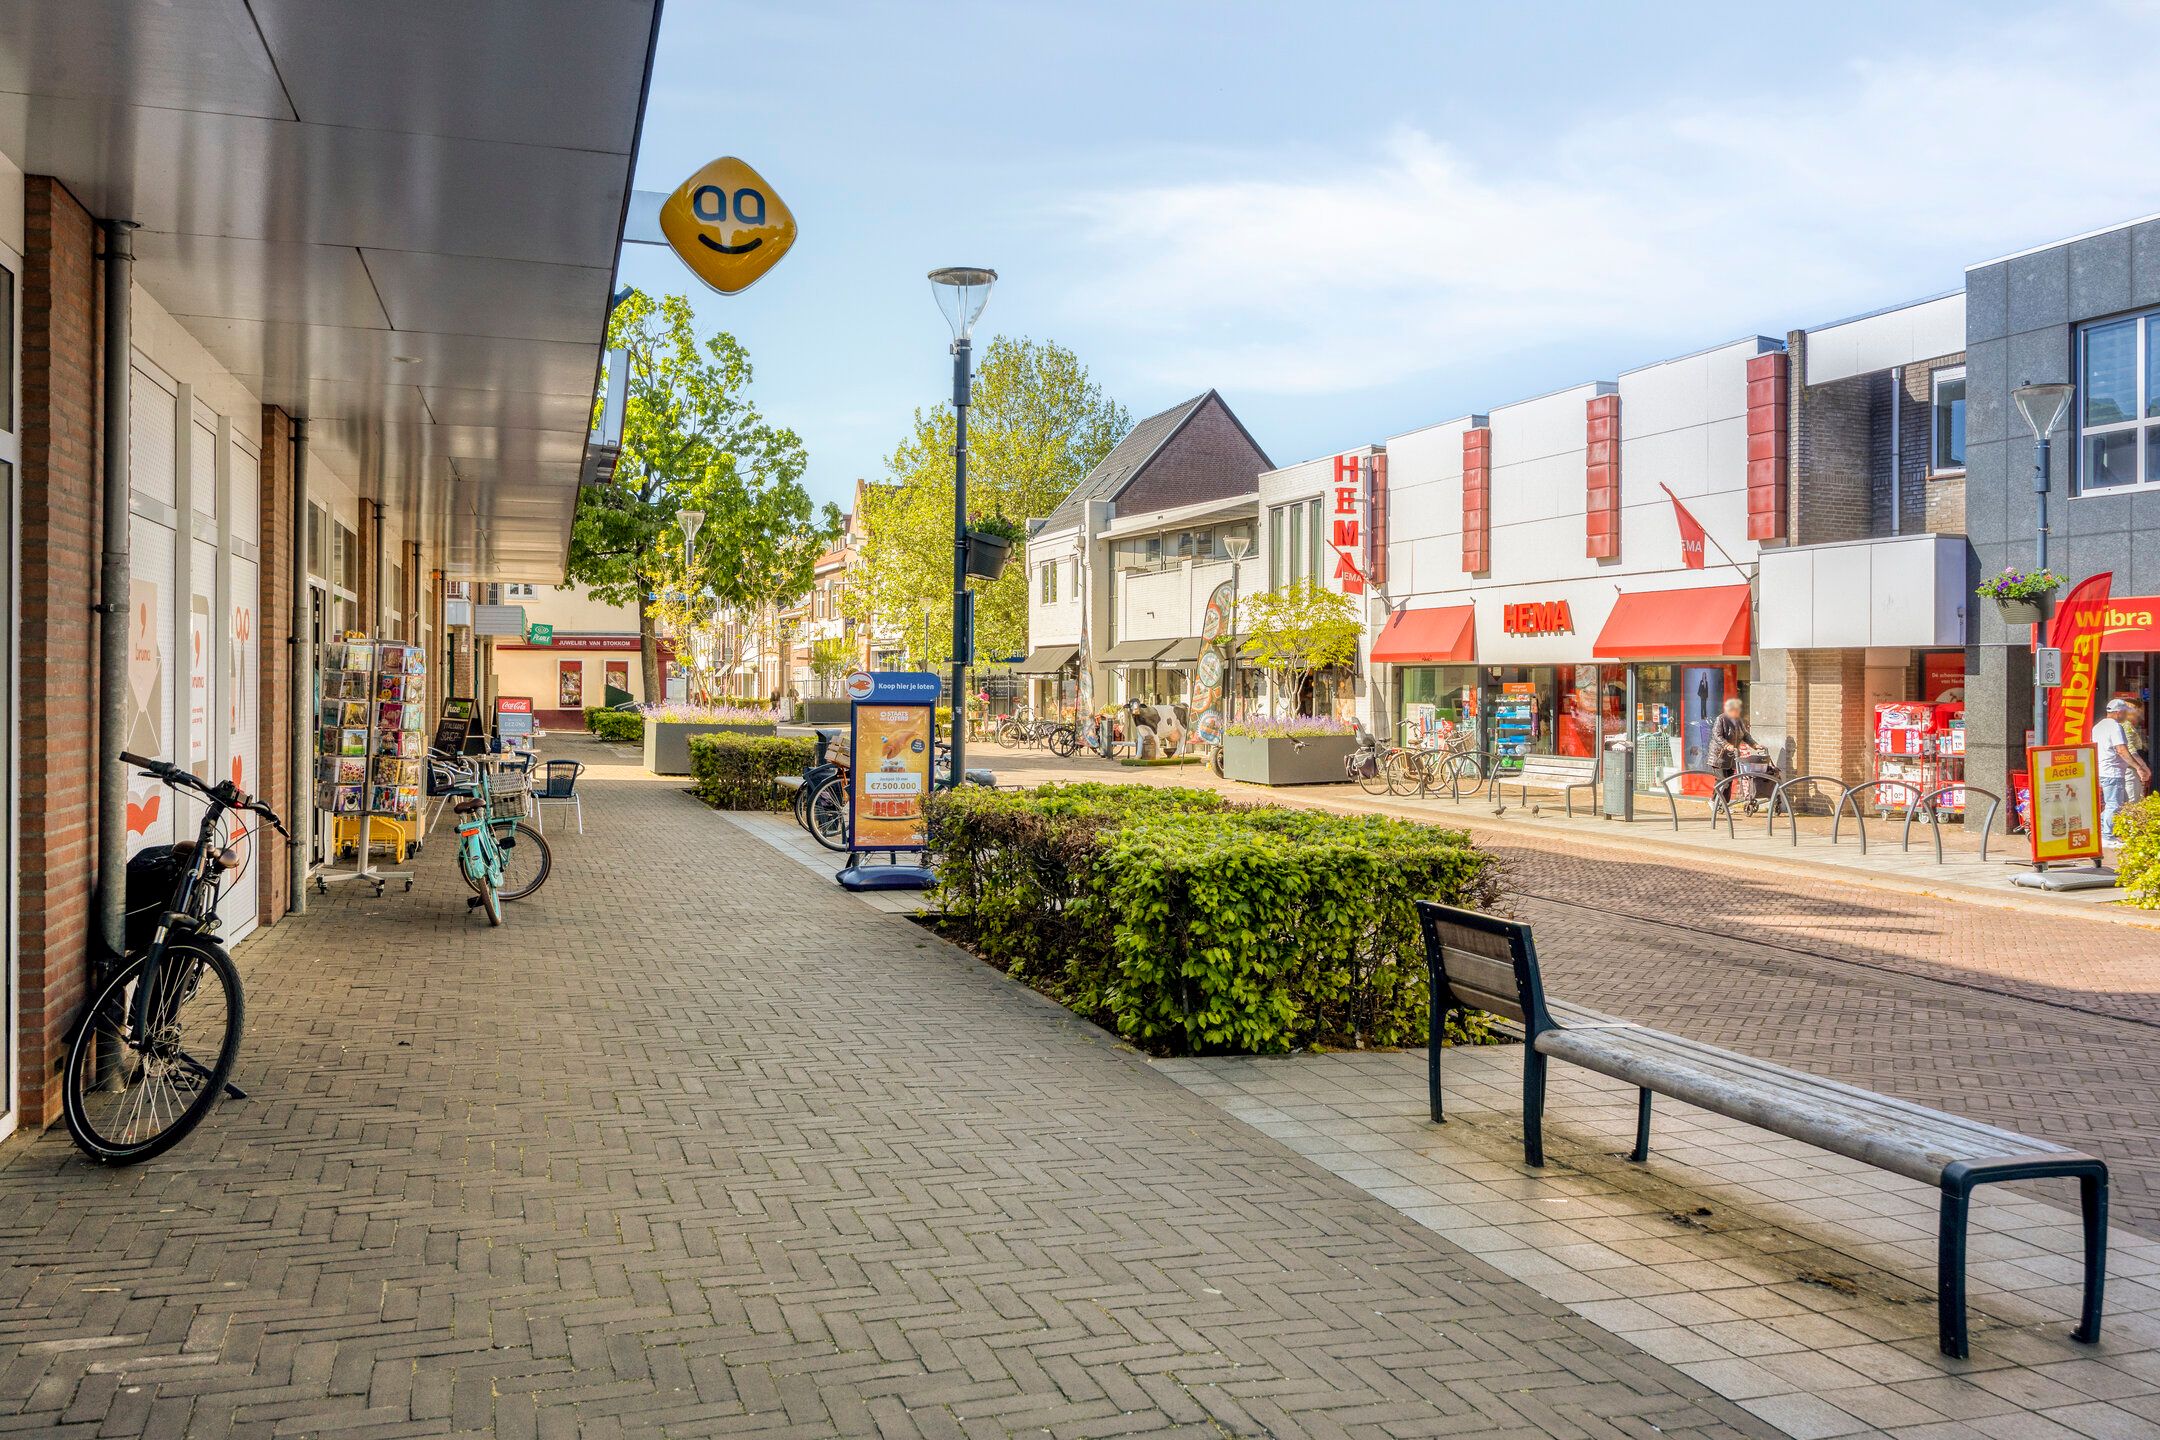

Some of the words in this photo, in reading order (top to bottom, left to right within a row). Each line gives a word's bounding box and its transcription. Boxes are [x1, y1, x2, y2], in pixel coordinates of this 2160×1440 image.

[1334, 455, 1359, 579] HEMA
[1682, 540, 1702, 552] EMA
[1343, 571, 1363, 583] EMA
[1503, 600, 1572, 633] HEMA
[2075, 605, 2153, 628] wibra
[878, 683, 896, 691] Koop
[897, 682, 909, 690] hier
[910, 683, 917, 691] je
[2061, 634, 2091, 745] wibra
[2051, 766, 2078, 778] Actie
[870, 782, 917, 790] €7.500.000
